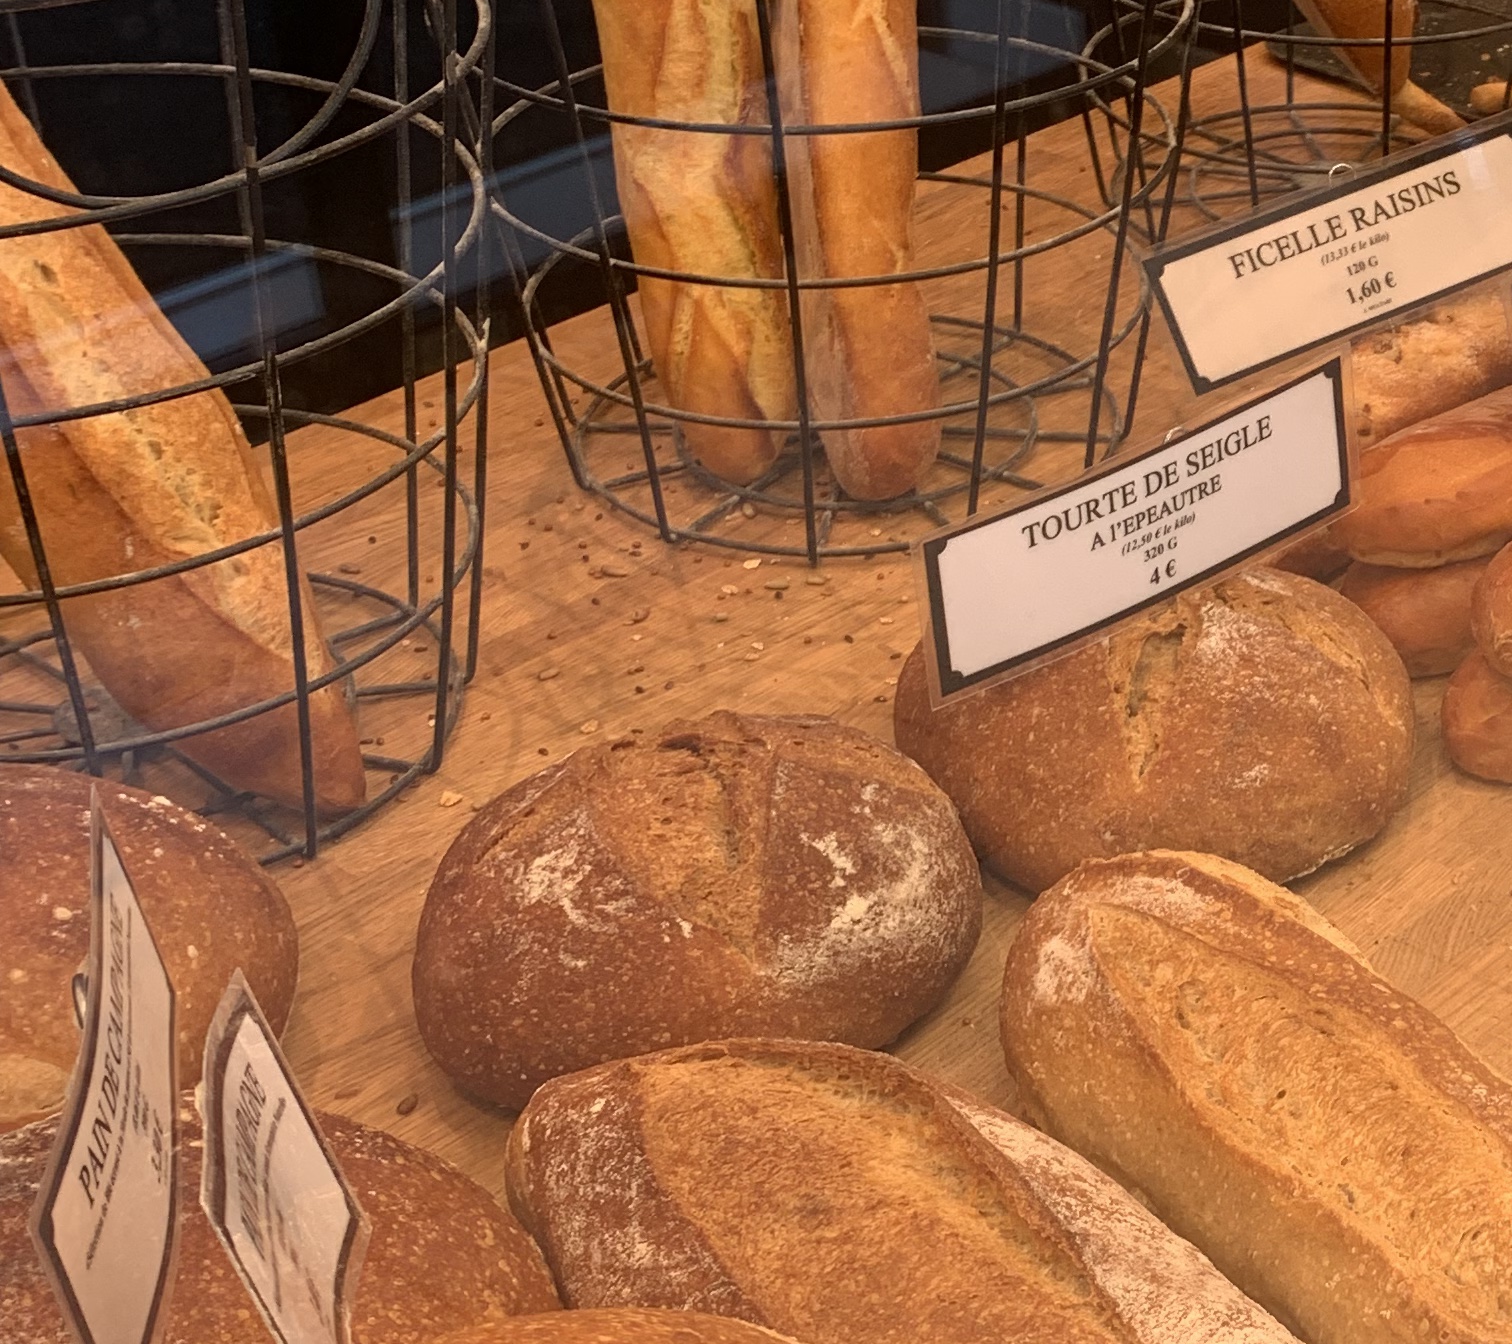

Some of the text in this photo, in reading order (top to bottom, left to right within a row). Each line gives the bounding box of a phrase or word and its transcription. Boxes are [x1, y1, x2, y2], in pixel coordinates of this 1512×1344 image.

[1229, 171, 1462, 280] FICELLE RAISINS
[1350, 242, 1358, 254] €
[1358, 240, 1368, 251] le
[1346, 255, 1379, 277] 120 G
[1346, 270, 1398, 305] 1,60 €
[1021, 414, 1273, 549] TOURTE DE SEIGLE
[1090, 531, 1106, 552] A
[1121, 512, 1196, 556] (12,50 € le kilo)
[1143, 536, 1178, 563] 320 G
[1150, 558, 1177, 585] 4 €
[79, 892, 124, 1210] PAIN DE CAMPAGNE
